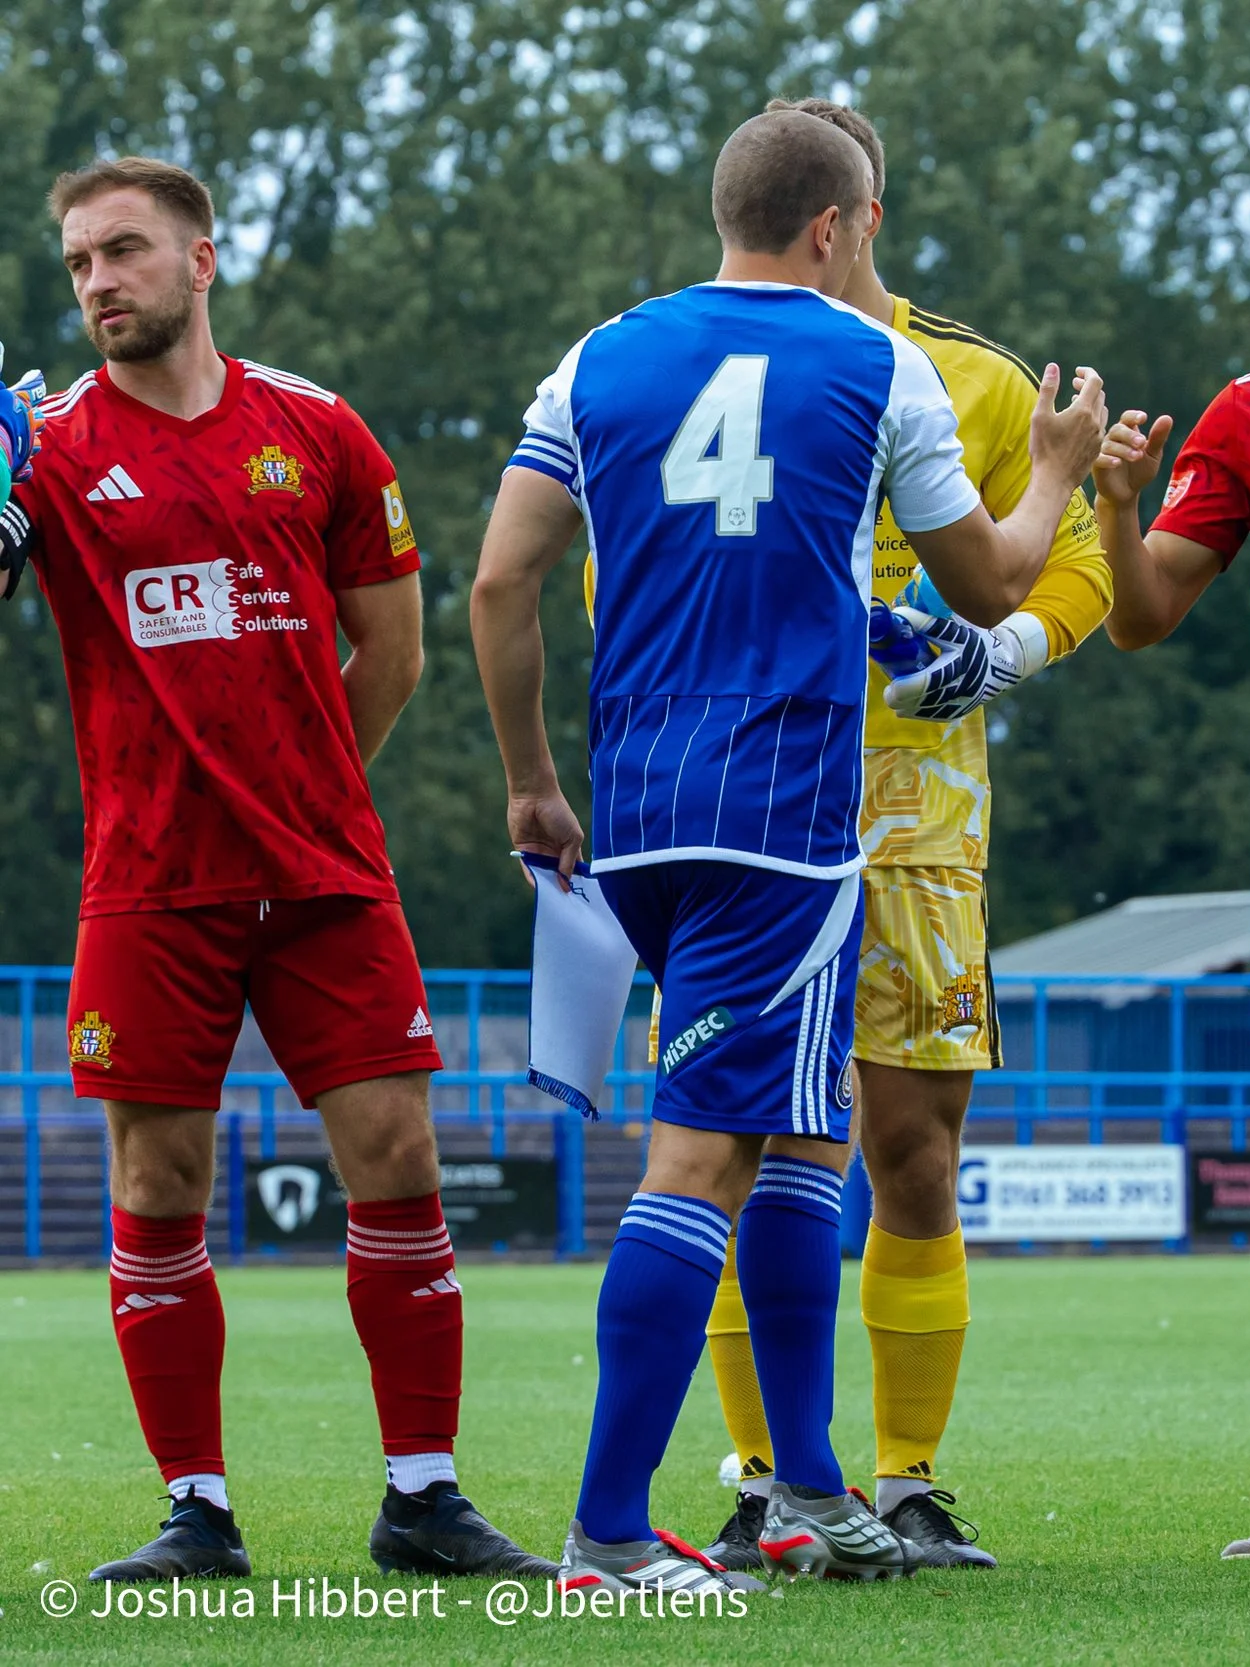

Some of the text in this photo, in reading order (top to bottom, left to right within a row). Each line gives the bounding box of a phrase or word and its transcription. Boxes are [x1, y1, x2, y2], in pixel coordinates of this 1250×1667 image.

[660, 354, 774, 536] 4
[873, 536, 909, 551] vice
[224, 562, 263, 581] Safe
[135, 573, 204, 615] CR
[228, 588, 290, 608] Service
[138, 612, 206, 629] SAFETY AND
[231, 614, 308, 634] Solutions
[140, 623, 207, 640] CONSUMABLES
